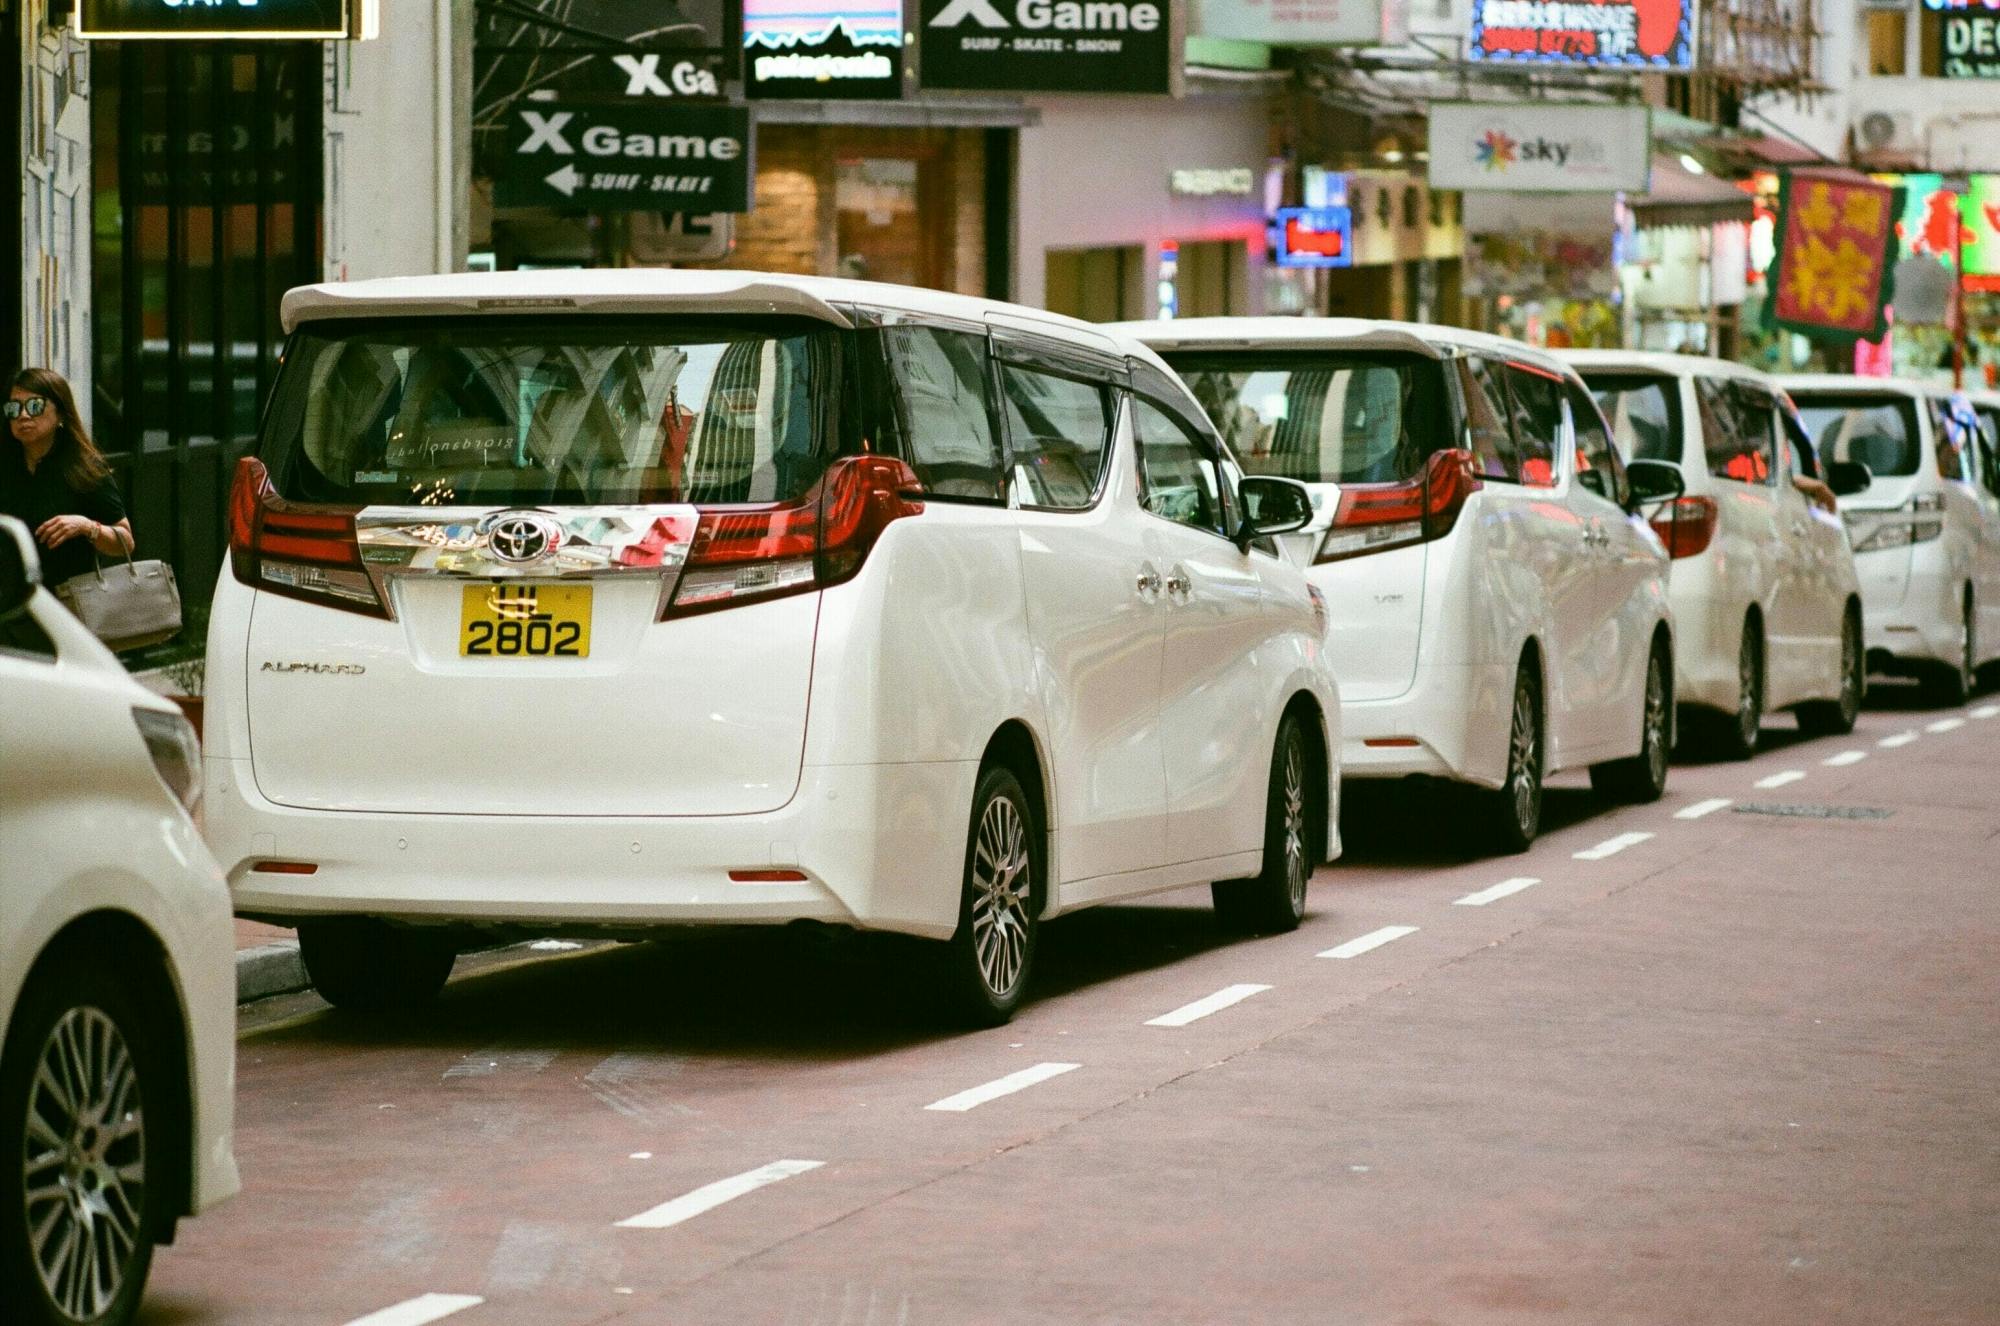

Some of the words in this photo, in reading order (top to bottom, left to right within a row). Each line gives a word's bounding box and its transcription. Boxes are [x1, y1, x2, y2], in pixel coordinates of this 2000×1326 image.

[1016, 0, 1160, 31] Game
[961, 37, 1001, 50] SURF
[1013, 38, 1063, 51] SKATE
[1076, 39, 1122, 52] SNOW
[1946, 17, 2000, 55] DE
[612, 54, 673, 96] X
[517, 111, 575, 153] X
[582, 126, 741, 159] Game
[590, 172, 641, 190] SURF
[650, 174, 712, 193] SKATE
[498, 586, 553, 620] HL
[467, 621, 580, 655] 2802
[260, 661, 366, 675] ALPHARD
